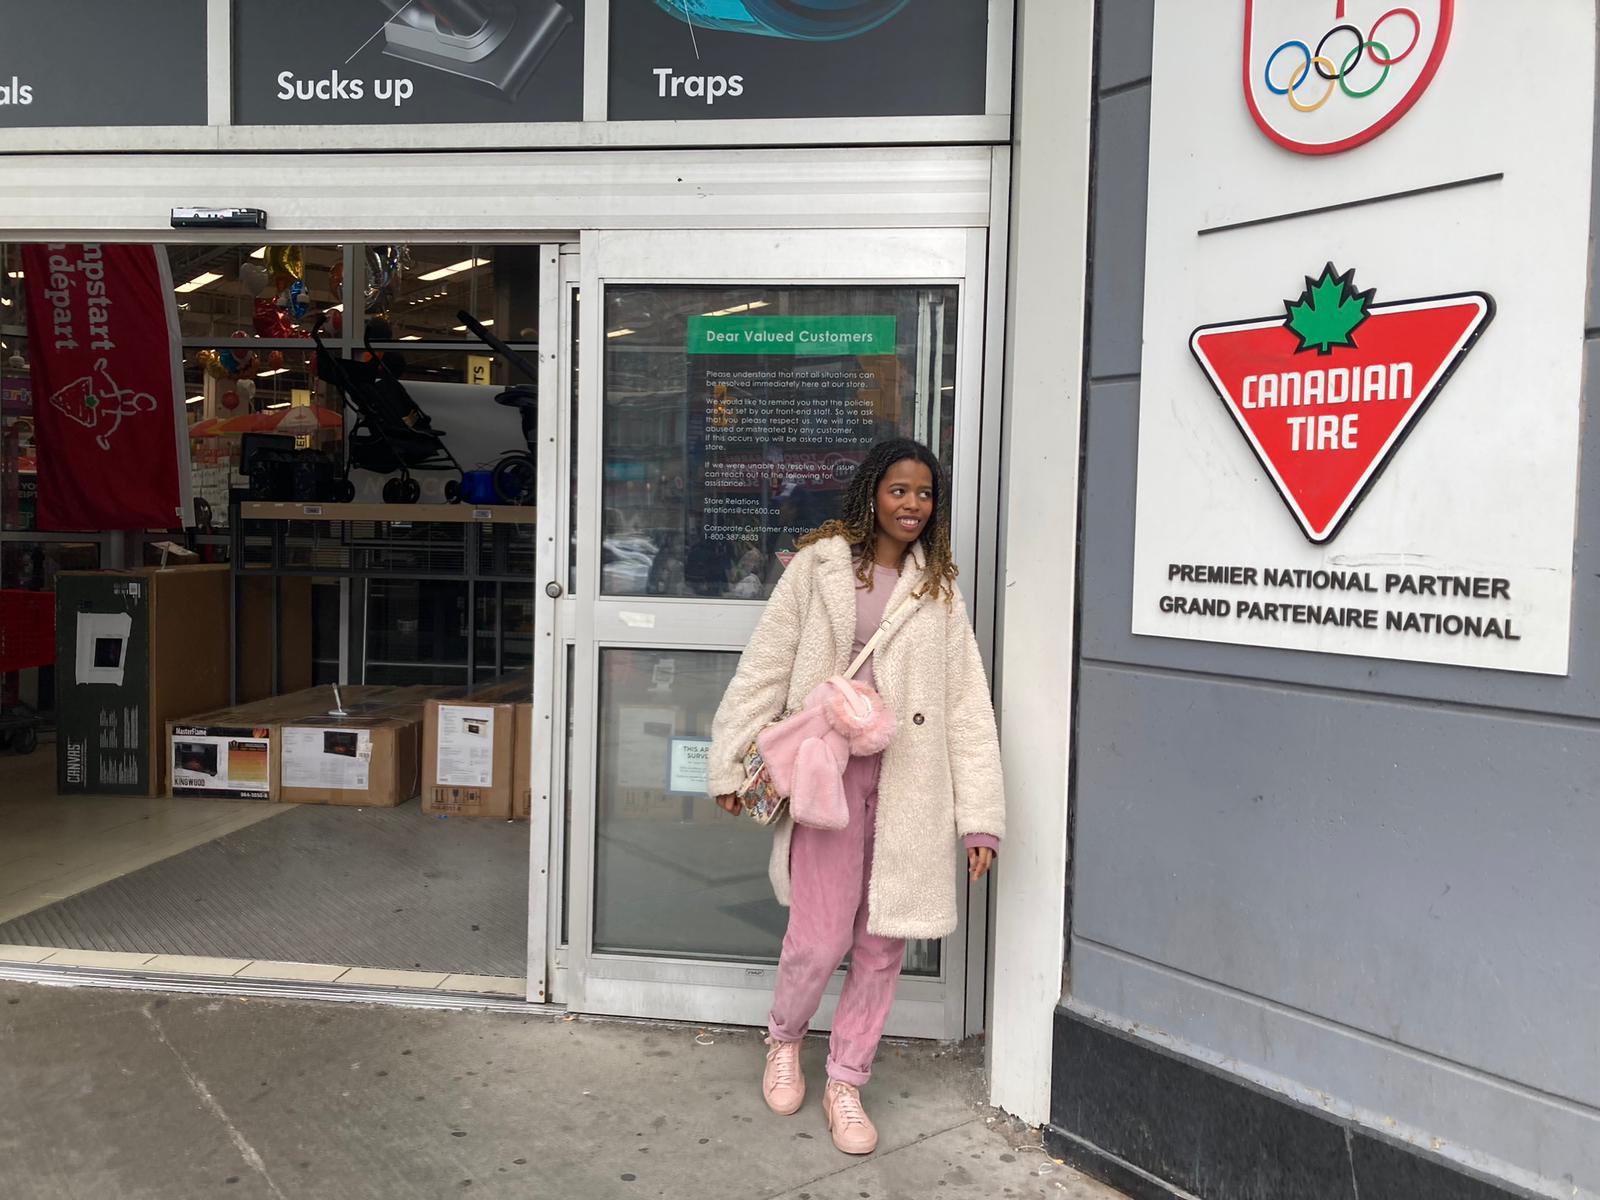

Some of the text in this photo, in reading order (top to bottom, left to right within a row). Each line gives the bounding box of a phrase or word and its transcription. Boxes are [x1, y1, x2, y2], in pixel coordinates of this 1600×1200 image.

[277, 69, 414, 107] Sucks up
[652, 67, 744, 105] Traps
[43, 257, 80, 351] départ
[706, 330, 873, 342] Dear Valued Customers
[706, 370, 731, 378] Please
[752, 380, 800, 389] immediately
[1242, 362, 1413, 409] CANADIAN
[749, 408, 759, 416] by
[813, 408, 833, 416] staff.
[835, 408, 845, 416] So
[705, 416, 721, 424] that
[741, 417, 767, 425] please
[788, 427, 798, 435] by
[1286, 413, 1359, 451] TIRE
[704, 460, 711, 468] If
[817, 464, 835, 472] your
[761, 471, 769, 479] to
[785, 472, 820, 481] following
[821, 472, 833, 480] for
[704, 497, 760, 505] Store Relations
[703, 524, 743, 532] Corporate
[744, 525, 781, 533] Customer
[1168, 563, 1511, 600] PREMIER NATIONAL PARTNER
[1159, 595, 1521, 641] GRAND PARTENAIRE NATIONAL
[67, 744, 81, 783] CANVAS
